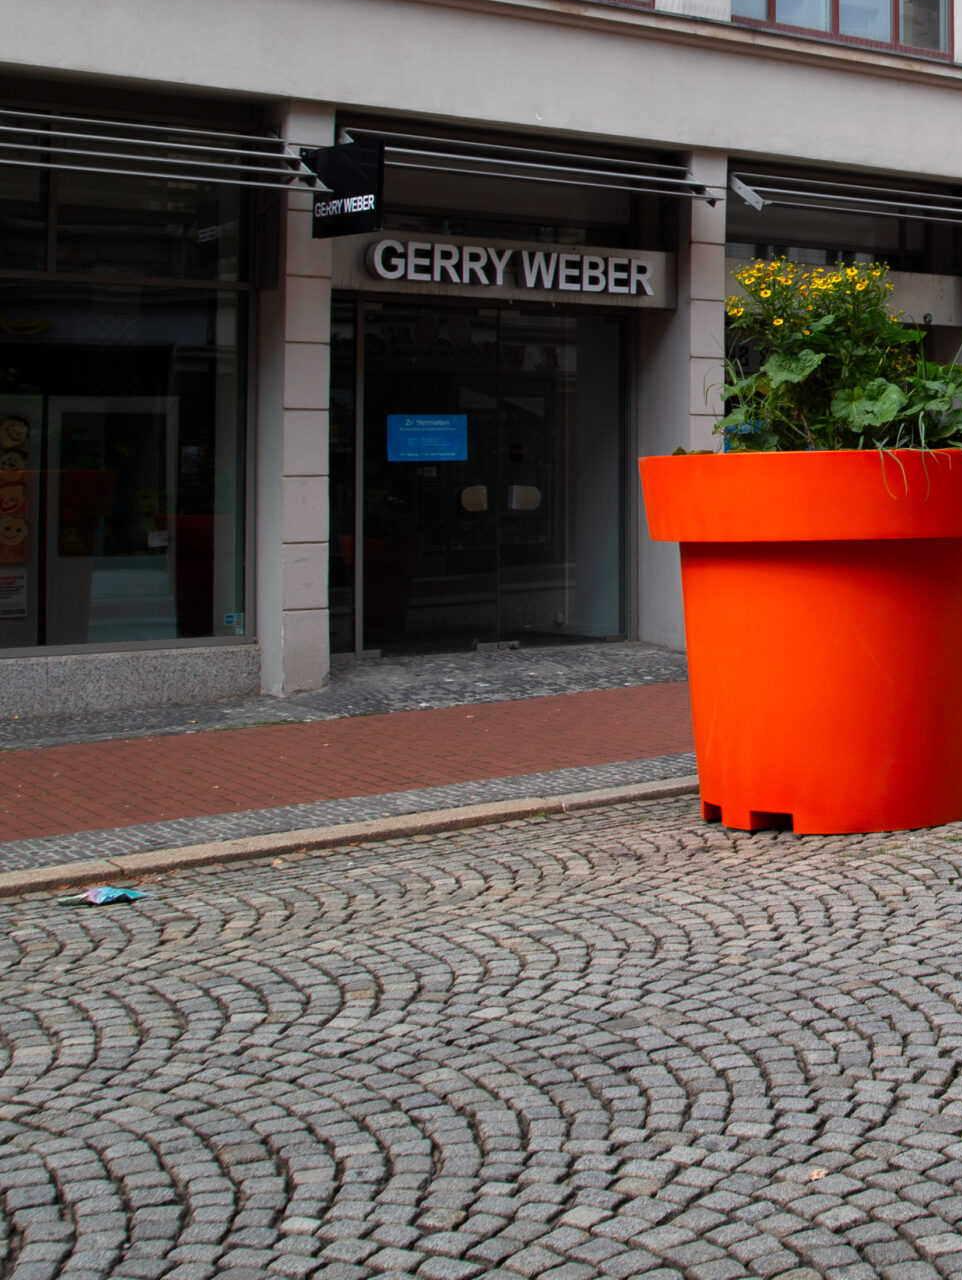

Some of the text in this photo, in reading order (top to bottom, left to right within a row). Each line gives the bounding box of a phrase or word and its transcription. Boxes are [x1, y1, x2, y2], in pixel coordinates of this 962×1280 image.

[315, 194, 375, 217] GERRY WEBER
[371, 238, 654, 296] GERRY WEBER
